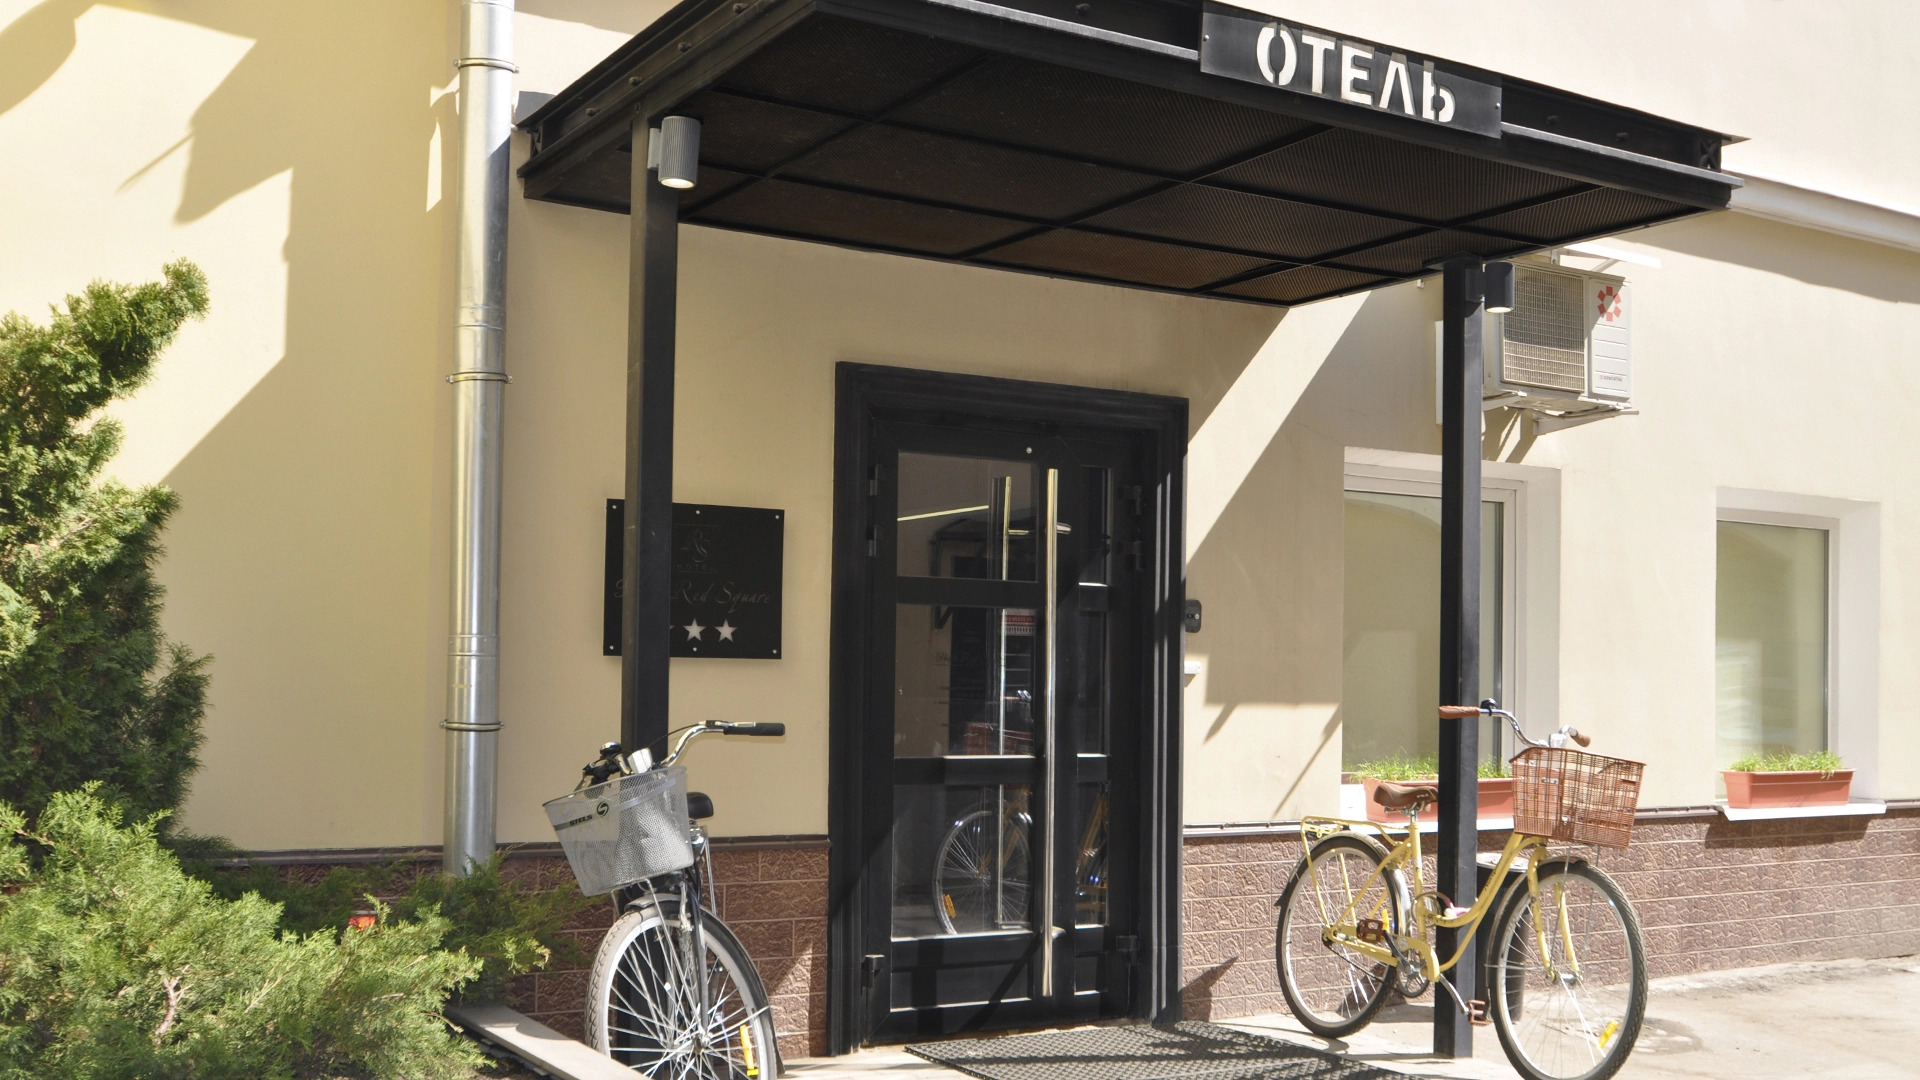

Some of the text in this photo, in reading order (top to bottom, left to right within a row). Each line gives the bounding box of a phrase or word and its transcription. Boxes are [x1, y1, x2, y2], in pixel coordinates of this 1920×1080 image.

[1256, 21, 1456, 123] ОТЕЛЬ
[673, 579, 771, 614] Red Square
[569, 814, 593, 826] STELS
